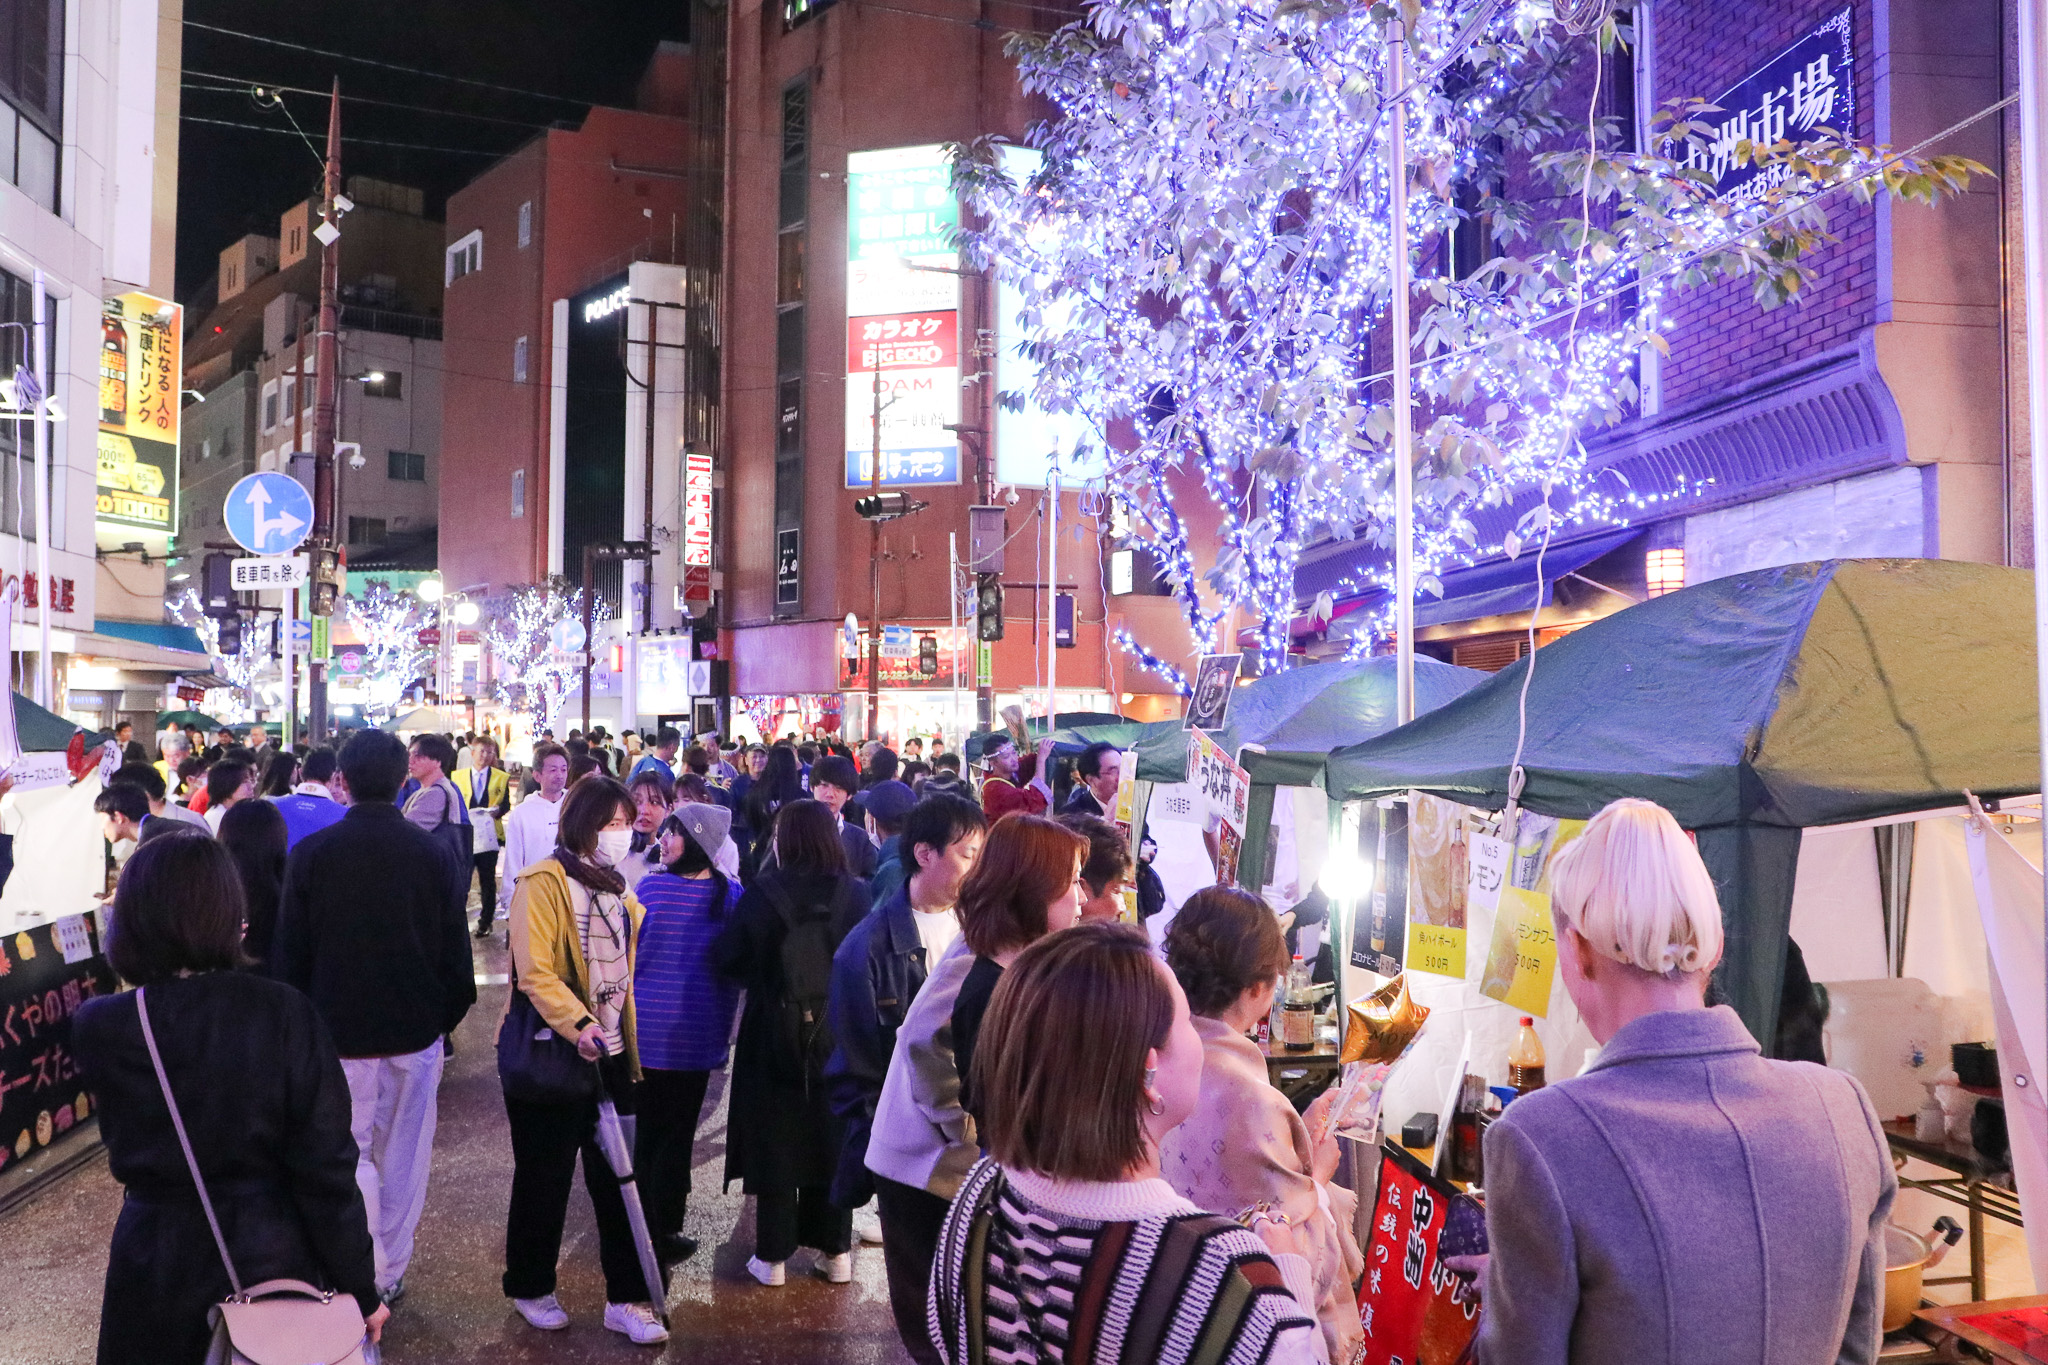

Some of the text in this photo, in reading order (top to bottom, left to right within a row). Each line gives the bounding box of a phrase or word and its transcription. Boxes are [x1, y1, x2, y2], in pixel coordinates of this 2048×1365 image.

[863, 318, 942, 340] カラオケ
[862, 345, 943, 368] BIG ECHO
[872, 377, 933, 393] DAM
[237, 564, 301, 583] 軽車両を除く
[1482, 842, 1499, 859] No.5
[1418, 931, 1457, 948] 角ハイボール
[1425, 955, 1449, 971] 500円
[1514, 953, 1541, 974] 500円
